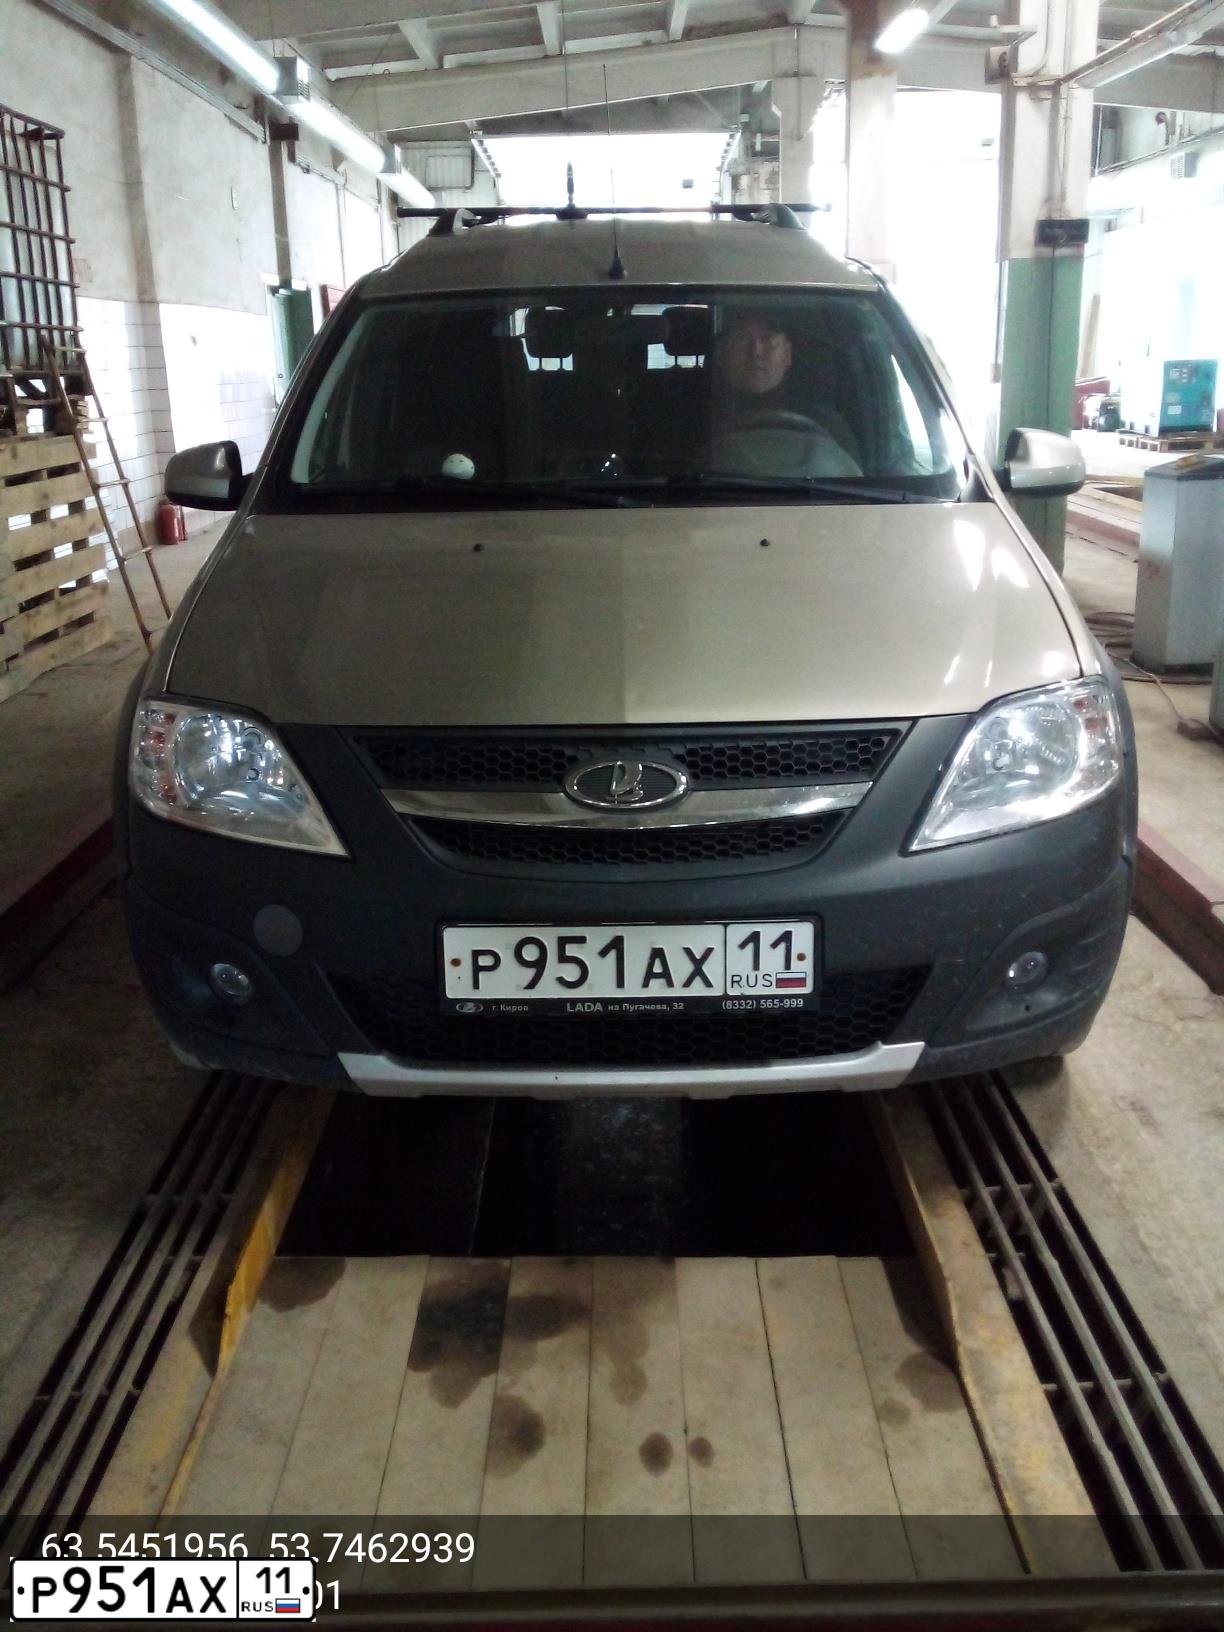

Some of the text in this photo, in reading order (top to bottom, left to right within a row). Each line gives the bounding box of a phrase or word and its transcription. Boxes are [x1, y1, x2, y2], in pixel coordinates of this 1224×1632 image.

[738, 930, 793, 971] 11
[730, 973, 774, 989] RUS
[500, 1002, 529, 1012] Киров
[566, 1002, 603, 1012] LADA
[672, 1002, 685, 1010] 32
[722, 998, 804, 1010] (8332) 565-999
